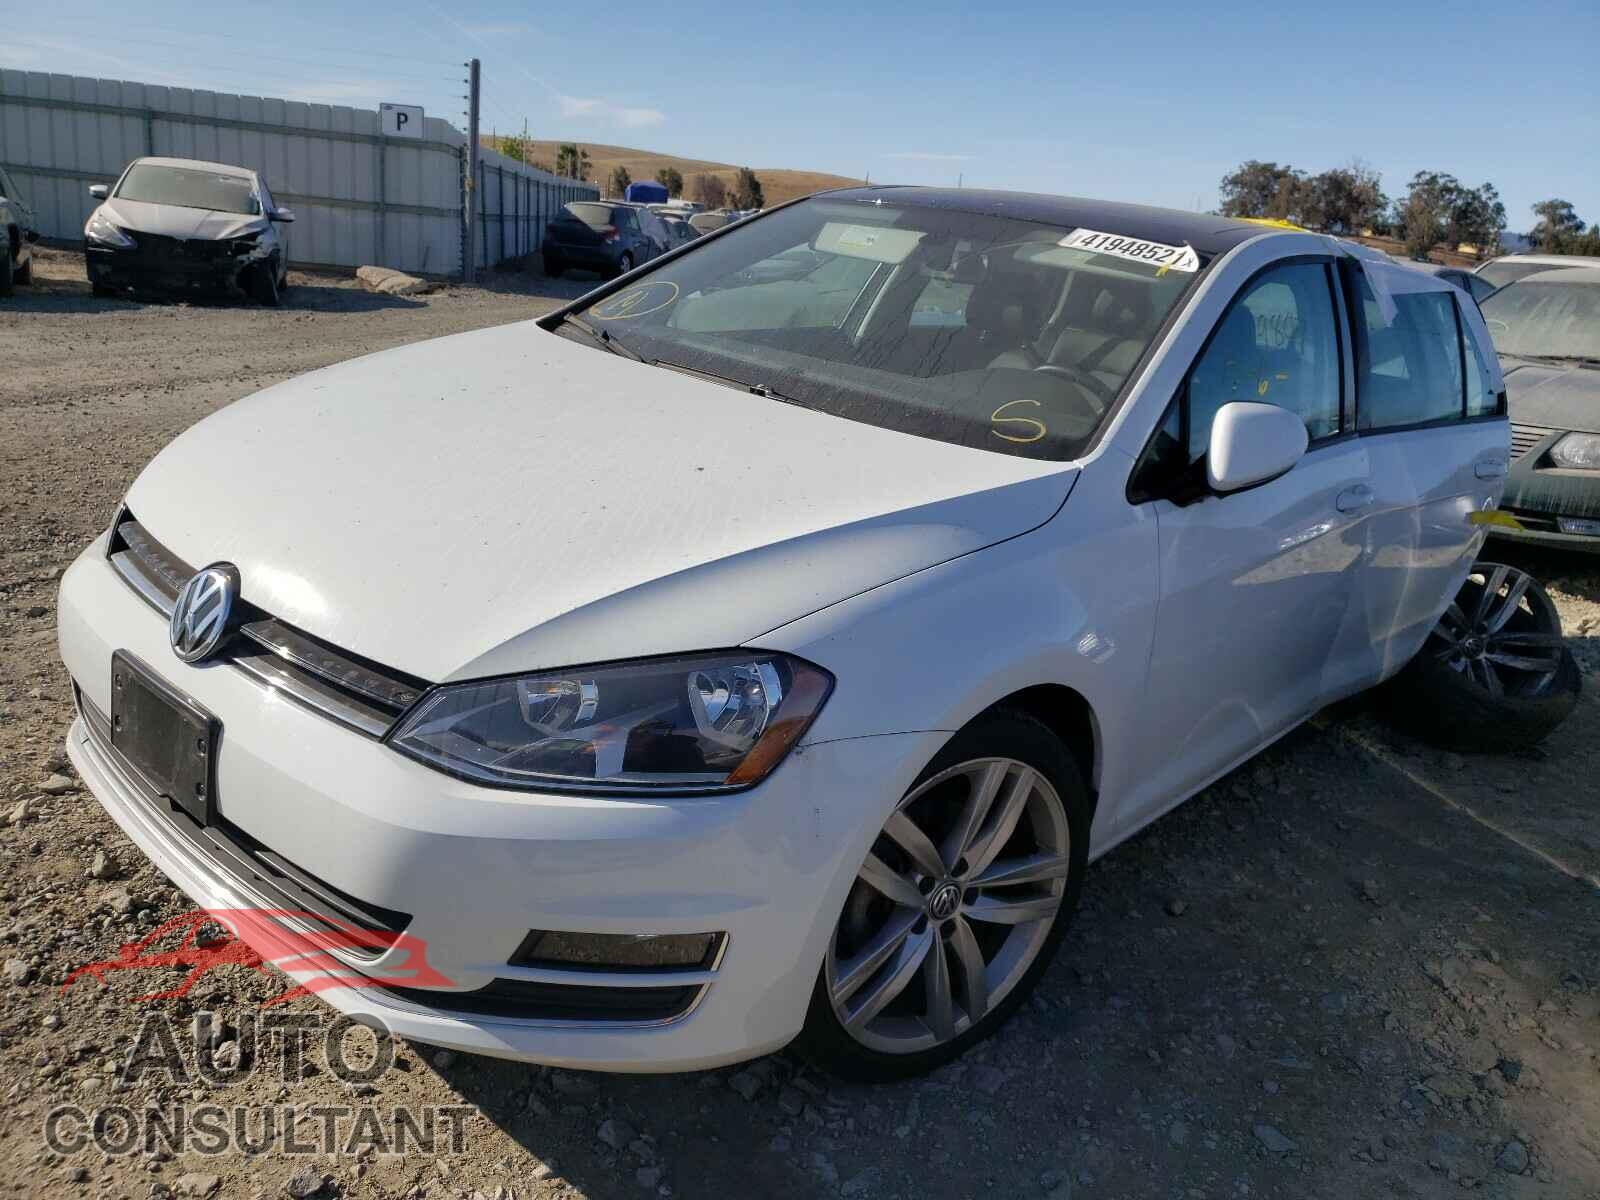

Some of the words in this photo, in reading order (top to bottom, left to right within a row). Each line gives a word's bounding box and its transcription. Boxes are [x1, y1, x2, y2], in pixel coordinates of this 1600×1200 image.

[397, 112, 408, 131] P
[1079, 233, 1188, 266] 41948521
[991, 399, 1047, 443] S
